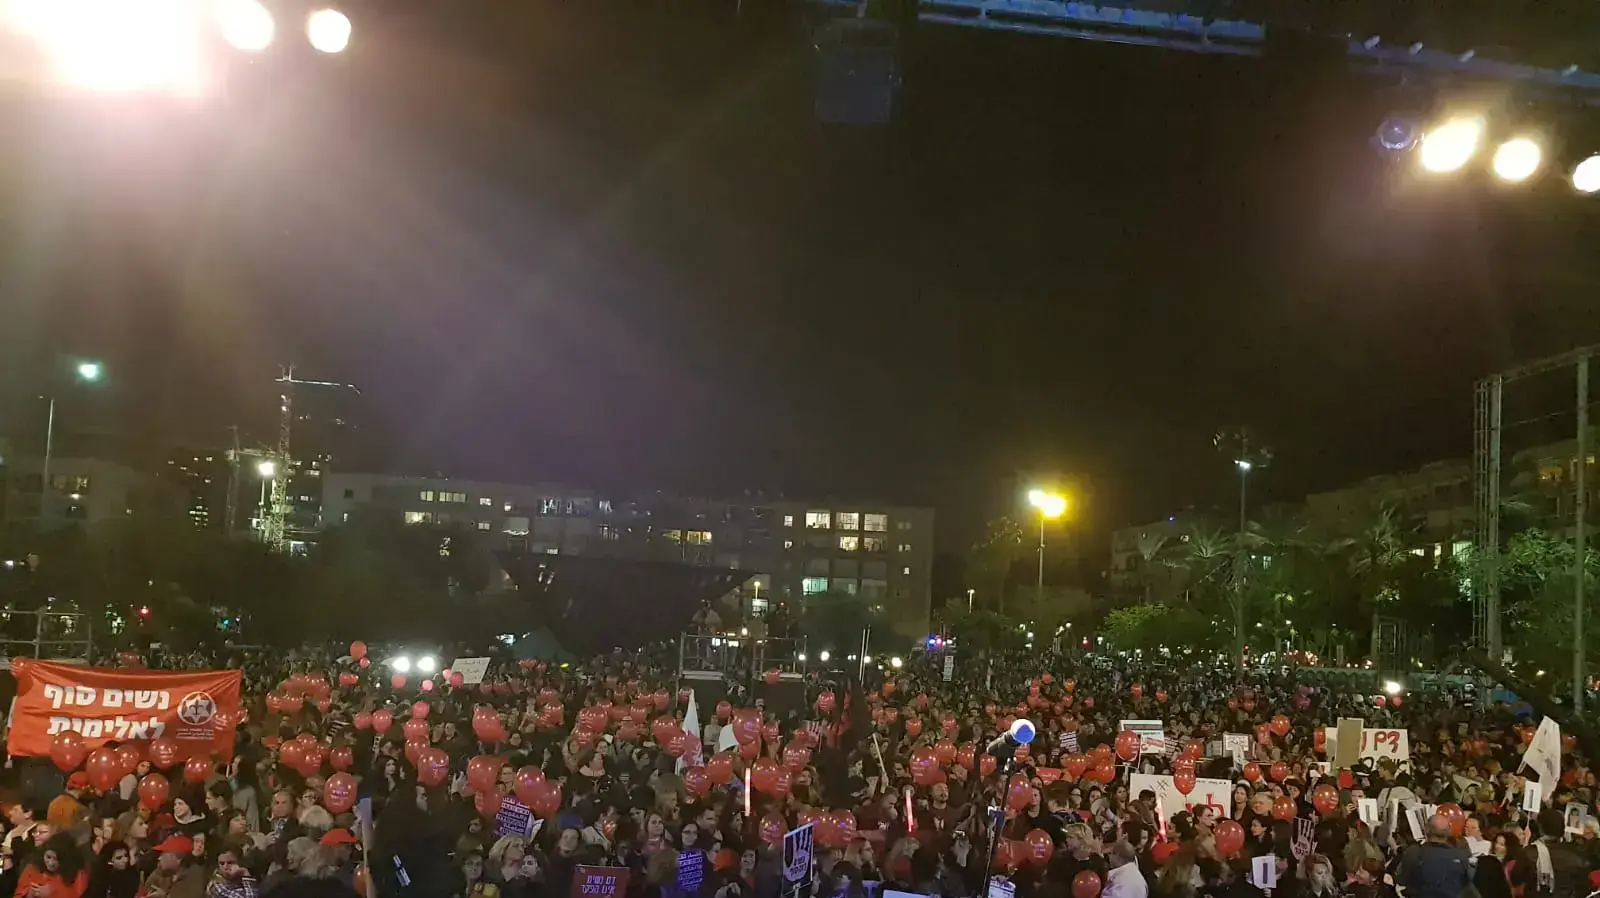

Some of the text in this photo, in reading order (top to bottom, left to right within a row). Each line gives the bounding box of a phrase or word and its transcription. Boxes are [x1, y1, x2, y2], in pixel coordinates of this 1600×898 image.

[44, 683, 170, 710] נשים סוף
[47, 716, 166, 741] לאלימות
